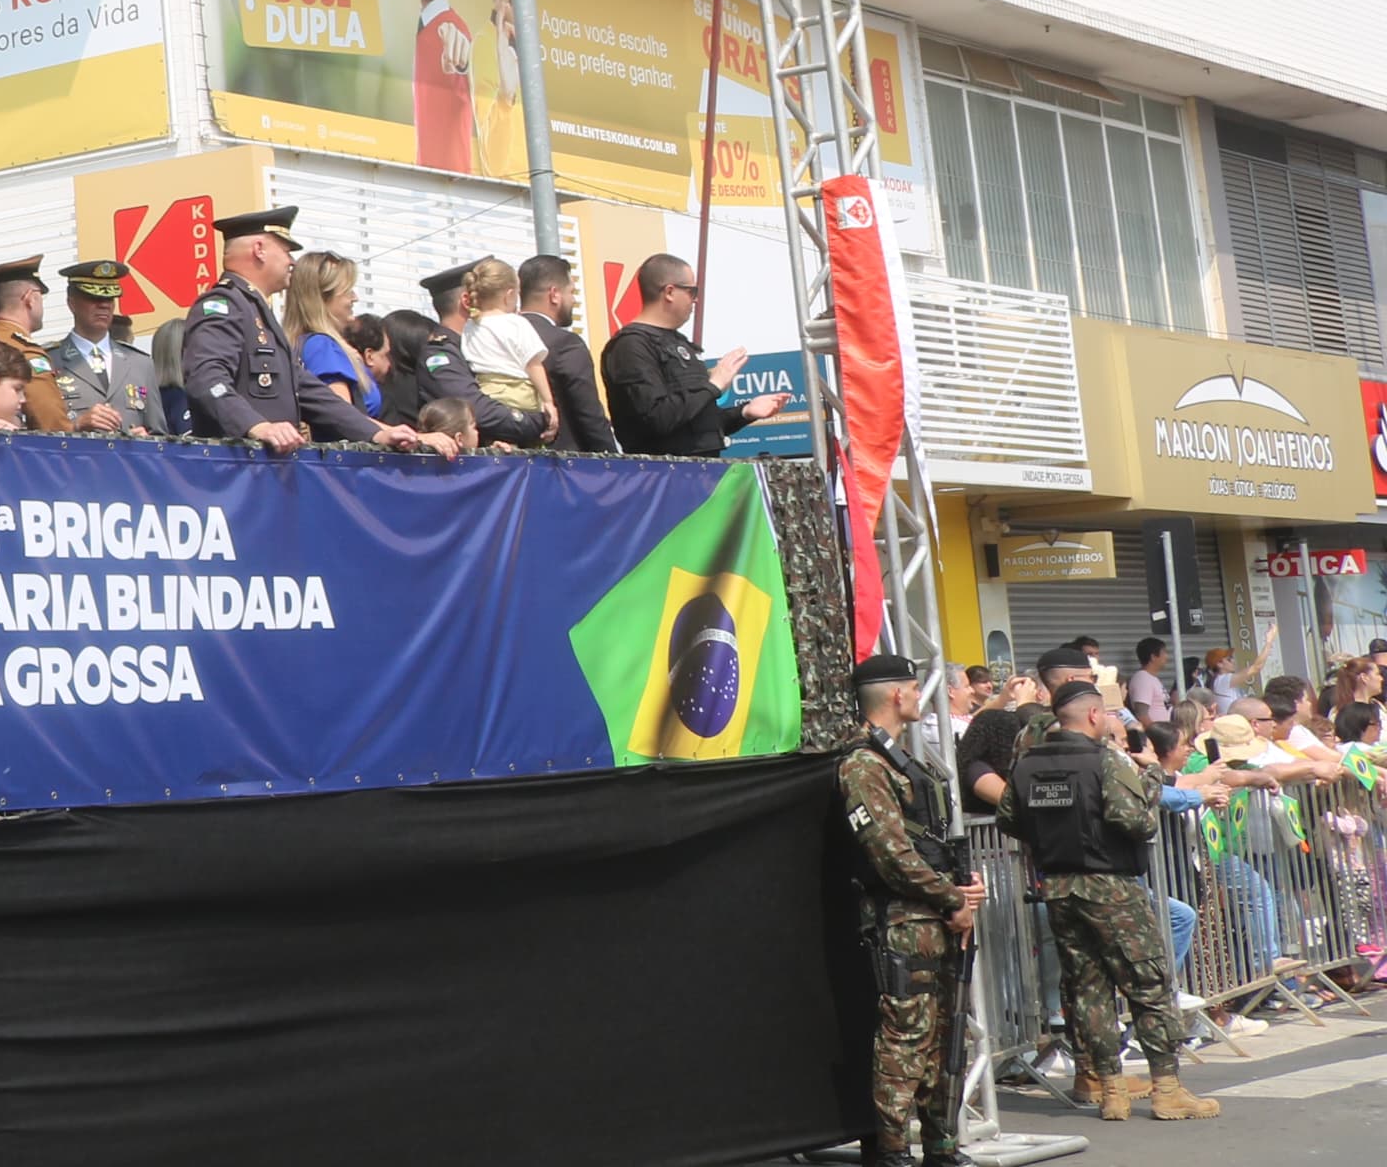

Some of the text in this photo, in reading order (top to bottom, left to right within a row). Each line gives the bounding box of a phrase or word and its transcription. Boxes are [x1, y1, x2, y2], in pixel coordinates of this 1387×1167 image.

[52, 13, 78, 38] da
[87, 0, 139, 30] Vida
[266, 4, 366, 49] DUPLA
[541, 9, 668, 59] Agora você escolhe
[551, 46, 576, 69] que
[580, 52, 626, 78] prefere
[629, 65, 676, 90] ganhar.
[550, 119, 678, 155] WWW.LENTESKODAK.COM.BR
[718, 184, 766, 199] DESCONTO
[732, 370, 793, 395] CIVIA
[1155, 417, 1334, 471] MARLON JOALHEIROS
[1022, 470, 1084, 485] UNIDADE PONTA GROSSA
[20, 499, 236, 561] BRIGADA
[1003, 552, 1104, 566] MARLON JOALHEIROS
[105, 573, 336, 631] BLINDADA
[1233, 583, 1251, 650] MARLON
[4, 644, 205, 706] GROSSA
[1046, 791, 1059, 799] DO
[848, 805, 871, 832] PE
